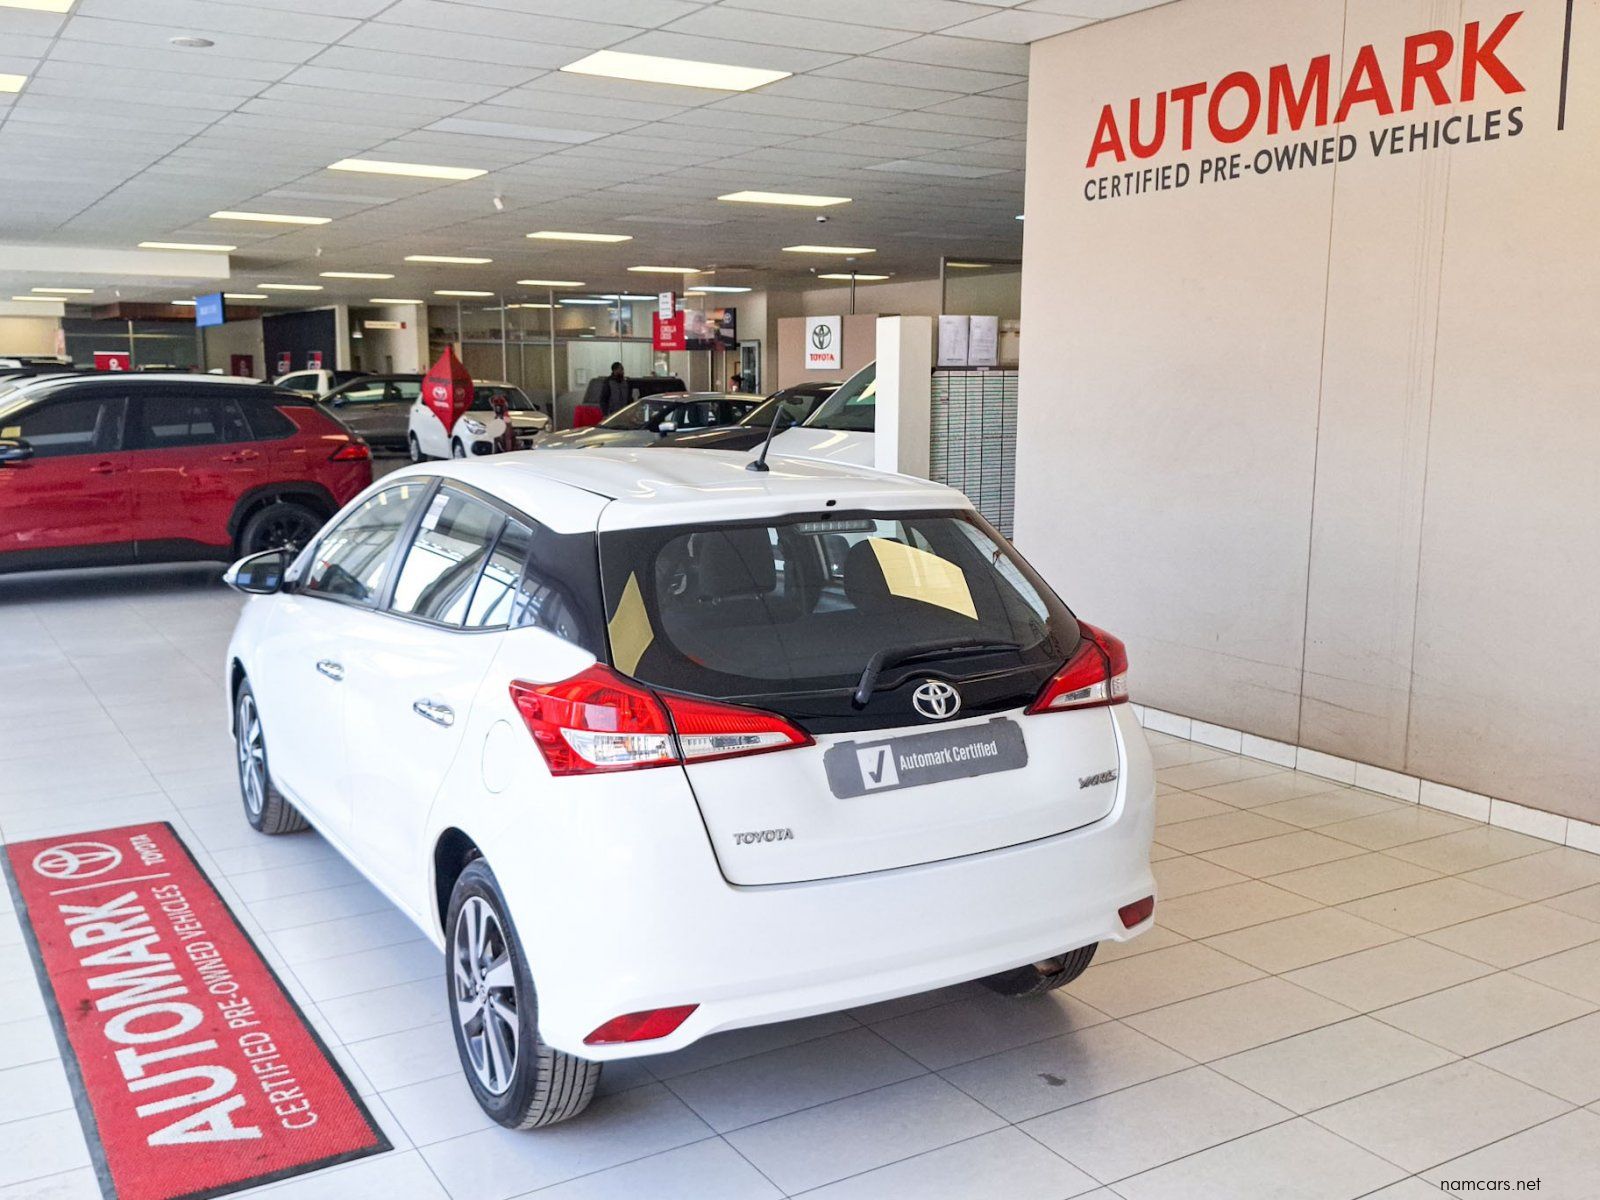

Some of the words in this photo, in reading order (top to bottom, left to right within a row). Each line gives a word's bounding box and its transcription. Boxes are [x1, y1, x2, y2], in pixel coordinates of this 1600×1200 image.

[1086, 10, 1526, 168] AUTOMARK
[1084, 162, 1190, 202] CERTIFIED
[1200, 133, 1357, 184] PRE-OWNED
[1369, 106, 1524, 157] VEHICLES
[809, 353, 835, 362] TOYOTA
[899, 749, 953, 771] Automark
[953, 740, 999, 761] Certified
[130, 834, 166, 867] TOYOTA
[733, 827, 794, 846] TOYOTA
[151, 883, 203, 942] VEHICLES
[58, 891, 264, 1147] AUTOMARK
[184, 940, 261, 1030] PRE-OWNED
[238, 1032, 319, 1131] CERTIFIED
